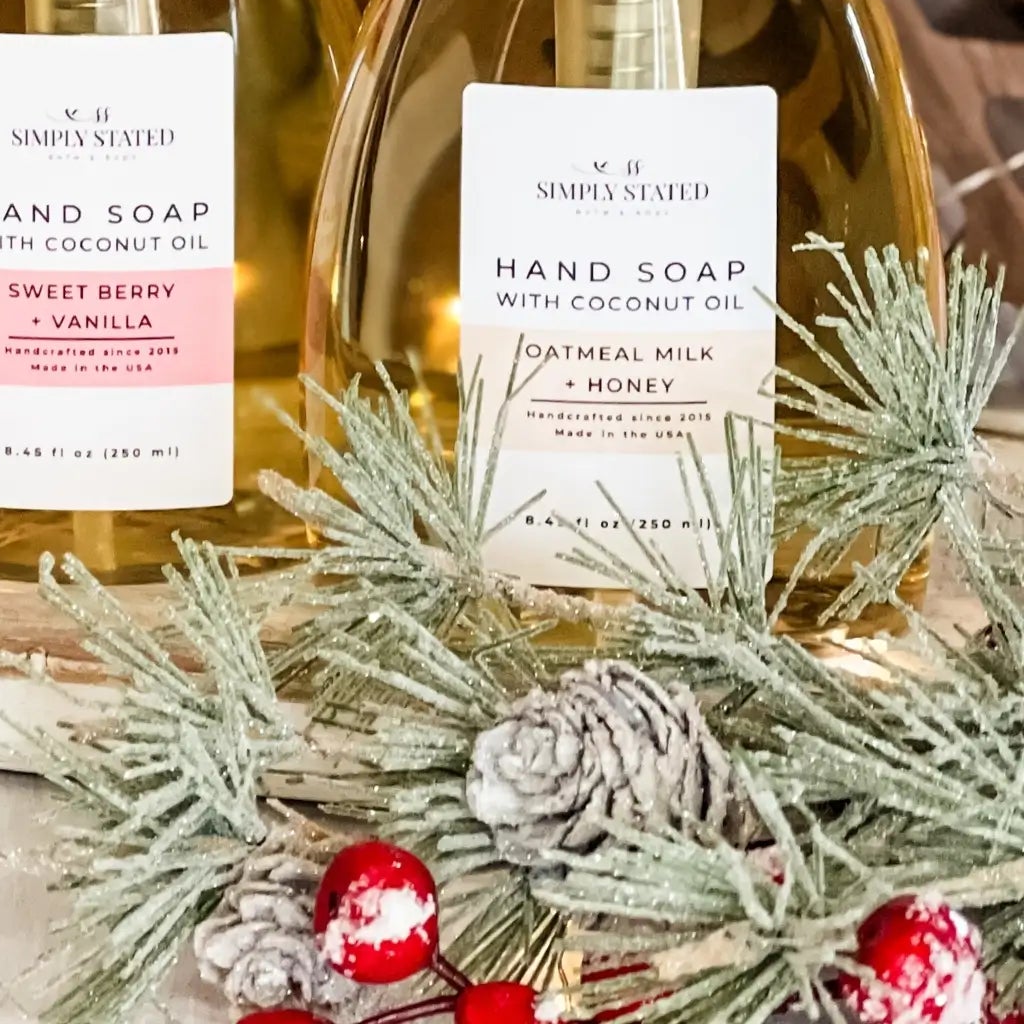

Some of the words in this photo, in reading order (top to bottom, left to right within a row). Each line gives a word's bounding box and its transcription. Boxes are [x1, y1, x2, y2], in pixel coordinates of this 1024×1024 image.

[11, 128, 86, 147] SIMPLY
[93, 128, 175, 147] STATED
[536, 180, 618, 201] SIMPLY
[624, 182, 710, 202] STATED
[108, 202, 209, 224] SOAP
[45, 236, 162, 252] COCONUT
[171, 235, 209, 250] OIL
[496, 257, 611, 282] HAND
[638, 260, 745, 283] SOAP
[8, 282, 89, 300] SWEET
[98, 283, 176, 300] BERRY
[496, 292, 560, 308] WITH
[571, 295, 694, 312] COCONUT
[704, 295, 744, 310] OIL
[32, 317, 41, 326] +
[51, 314, 153, 329] VANILLA
[5, 346, 95, 357] Handcrafted
[103, 347, 140, 356] since
[526, 344, 644, 361] OATMEAL
[656, 346, 714, 362] MILK
[31, 364, 67, 372] Made
[74, 364, 87, 372] in
[95, 363, 118, 372] the
[126, 363, 153, 372] USA
[566, 380, 575, 388] +
[588, 378, 674, 394] HONEY
[527, 410, 623, 422] Handcrafted
[632, 413, 672, 422] since
[680, 412, 711, 422] 2015
[555, 428, 593, 438] Made
[602, 429, 616, 438] in
[624, 429, 648, 438] the
[655, 430, 684, 438] USA
[4, 446, 42, 457] 8.45
[52, 447, 64, 458] fl
[74, 449, 93, 458] oz
[103, 447, 141, 460] (250
[151, 446, 180, 458] ml)
[526, 515, 566, 528] 8.4
[576, 517, 588, 528] fl
[600, 520, 620, 529] oz
